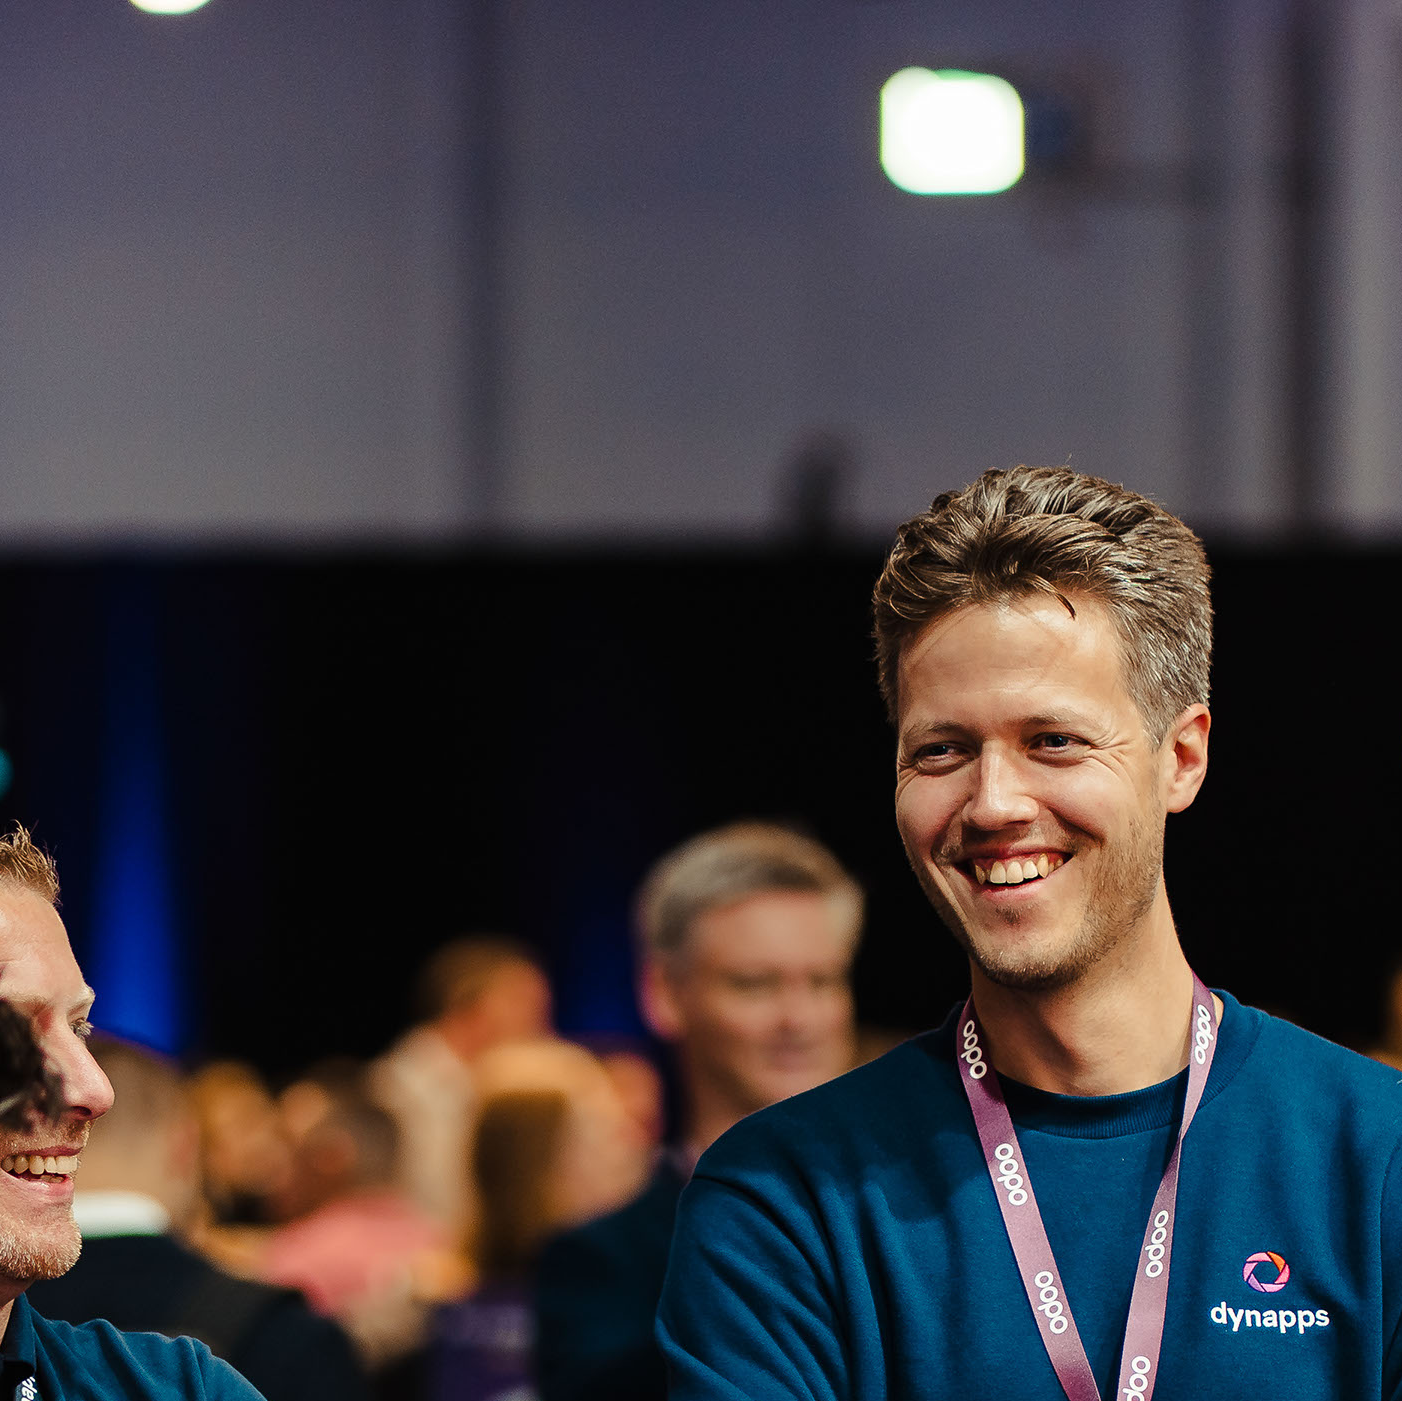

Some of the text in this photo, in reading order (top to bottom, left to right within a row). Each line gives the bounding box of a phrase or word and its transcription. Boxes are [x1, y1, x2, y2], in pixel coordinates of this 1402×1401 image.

[961, 1020, 987, 1080] odoo
[1194, 1004, 1214, 1065] odoo
[994, 1143, 1028, 1206] odoo
[1145, 1210, 1170, 1278] odoo
[1034, 1271, 1068, 1334] odoo
[1210, 1301, 1330, 1334] dynapps
